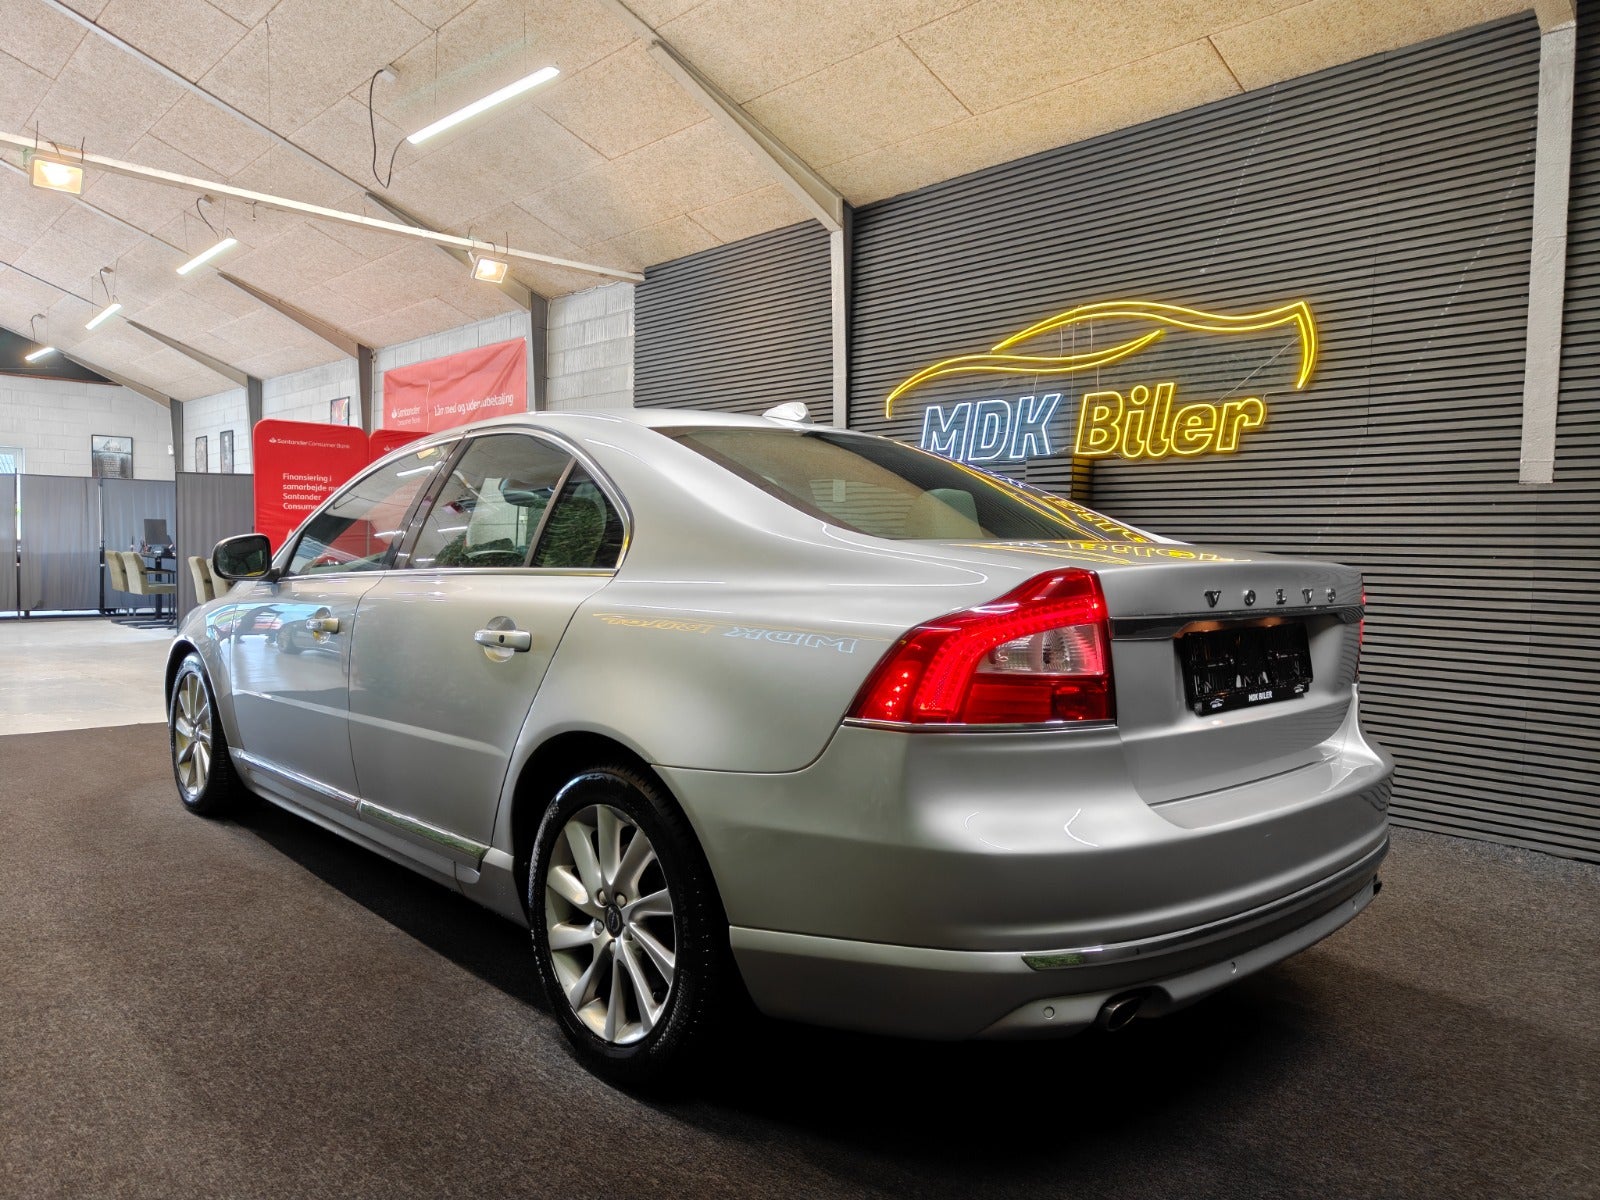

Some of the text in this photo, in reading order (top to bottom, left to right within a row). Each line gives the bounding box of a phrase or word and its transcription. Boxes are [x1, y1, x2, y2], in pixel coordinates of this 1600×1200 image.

[457, 403, 465, 415] og
[921, 382, 1267, 463] MDK Biler
[277, 438, 307, 446] Santander
[282, 472, 328, 483] Finansiering
[282, 483, 327, 492] samarbejde
[282, 493, 322, 501] Santander
[282, 502, 318, 510] Consume
[1204, 588, 1337, 608] VOLVO
[1258, 690, 1273, 701] BILER
